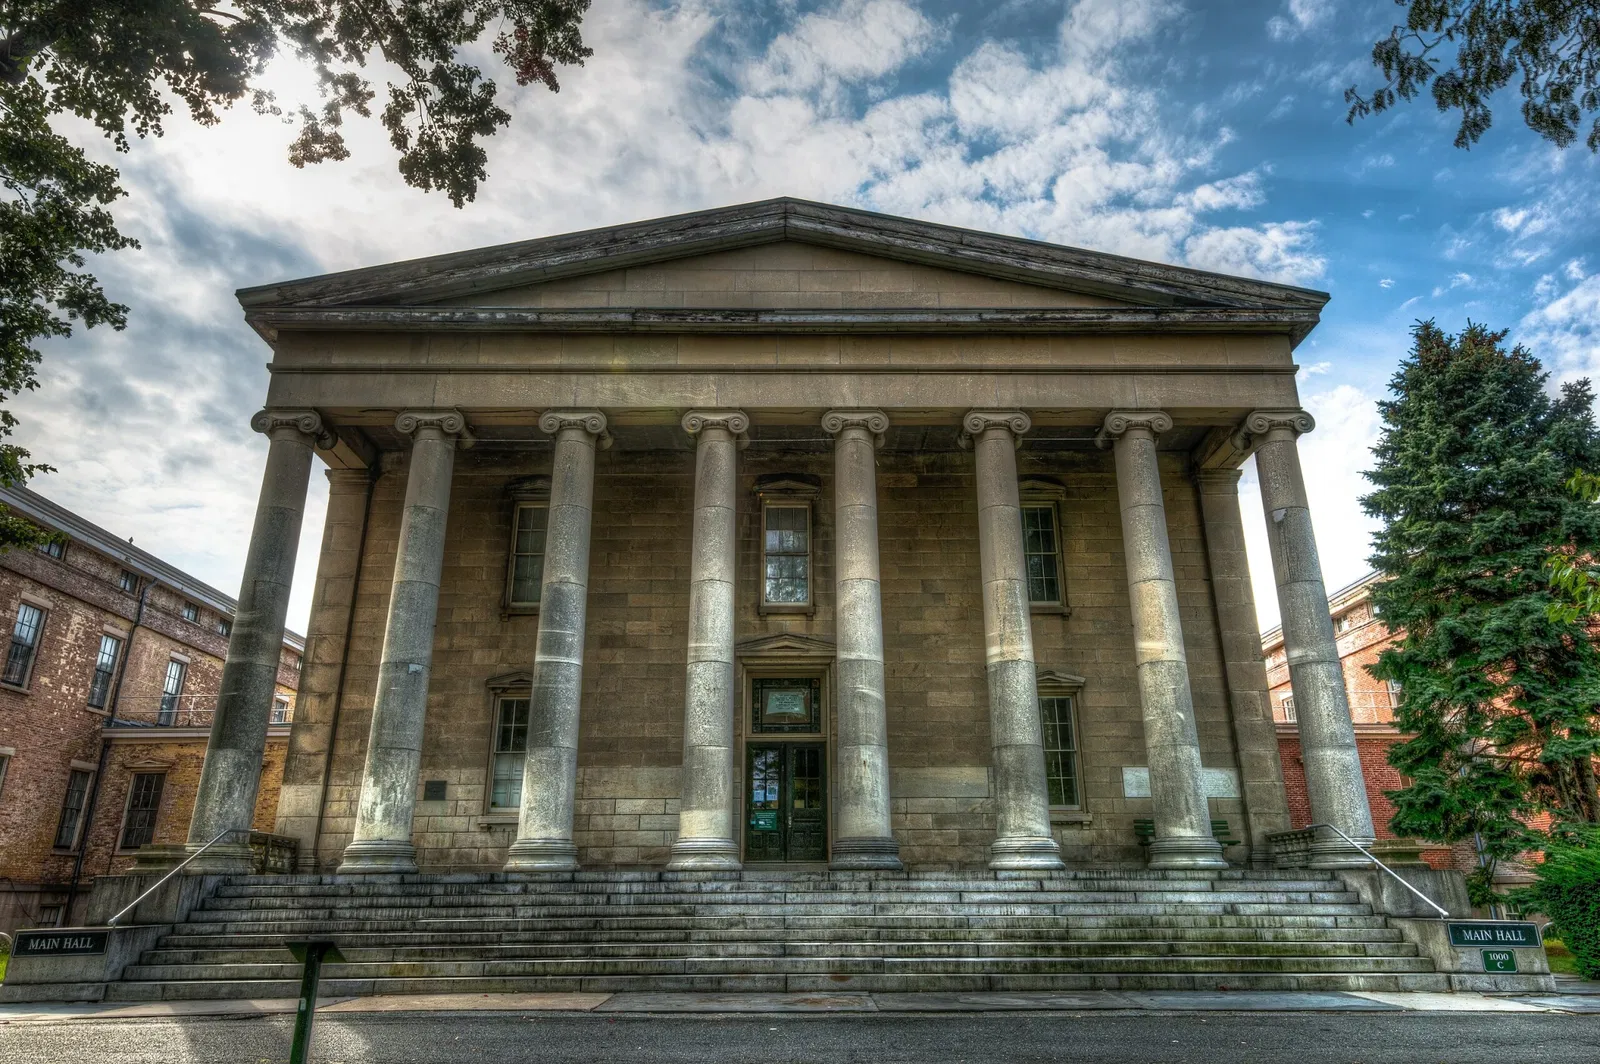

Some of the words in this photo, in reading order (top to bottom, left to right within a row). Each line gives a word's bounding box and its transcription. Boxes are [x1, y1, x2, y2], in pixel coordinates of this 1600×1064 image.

[1462, 929, 1493, 941] MAIN
[1496, 930, 1526, 941] HALL
[28, 938, 60, 950] MAIN
[62, 937, 94, 949] HALL
[1489, 953, 1509, 961] 1000
[1497, 961, 1504, 969] C
